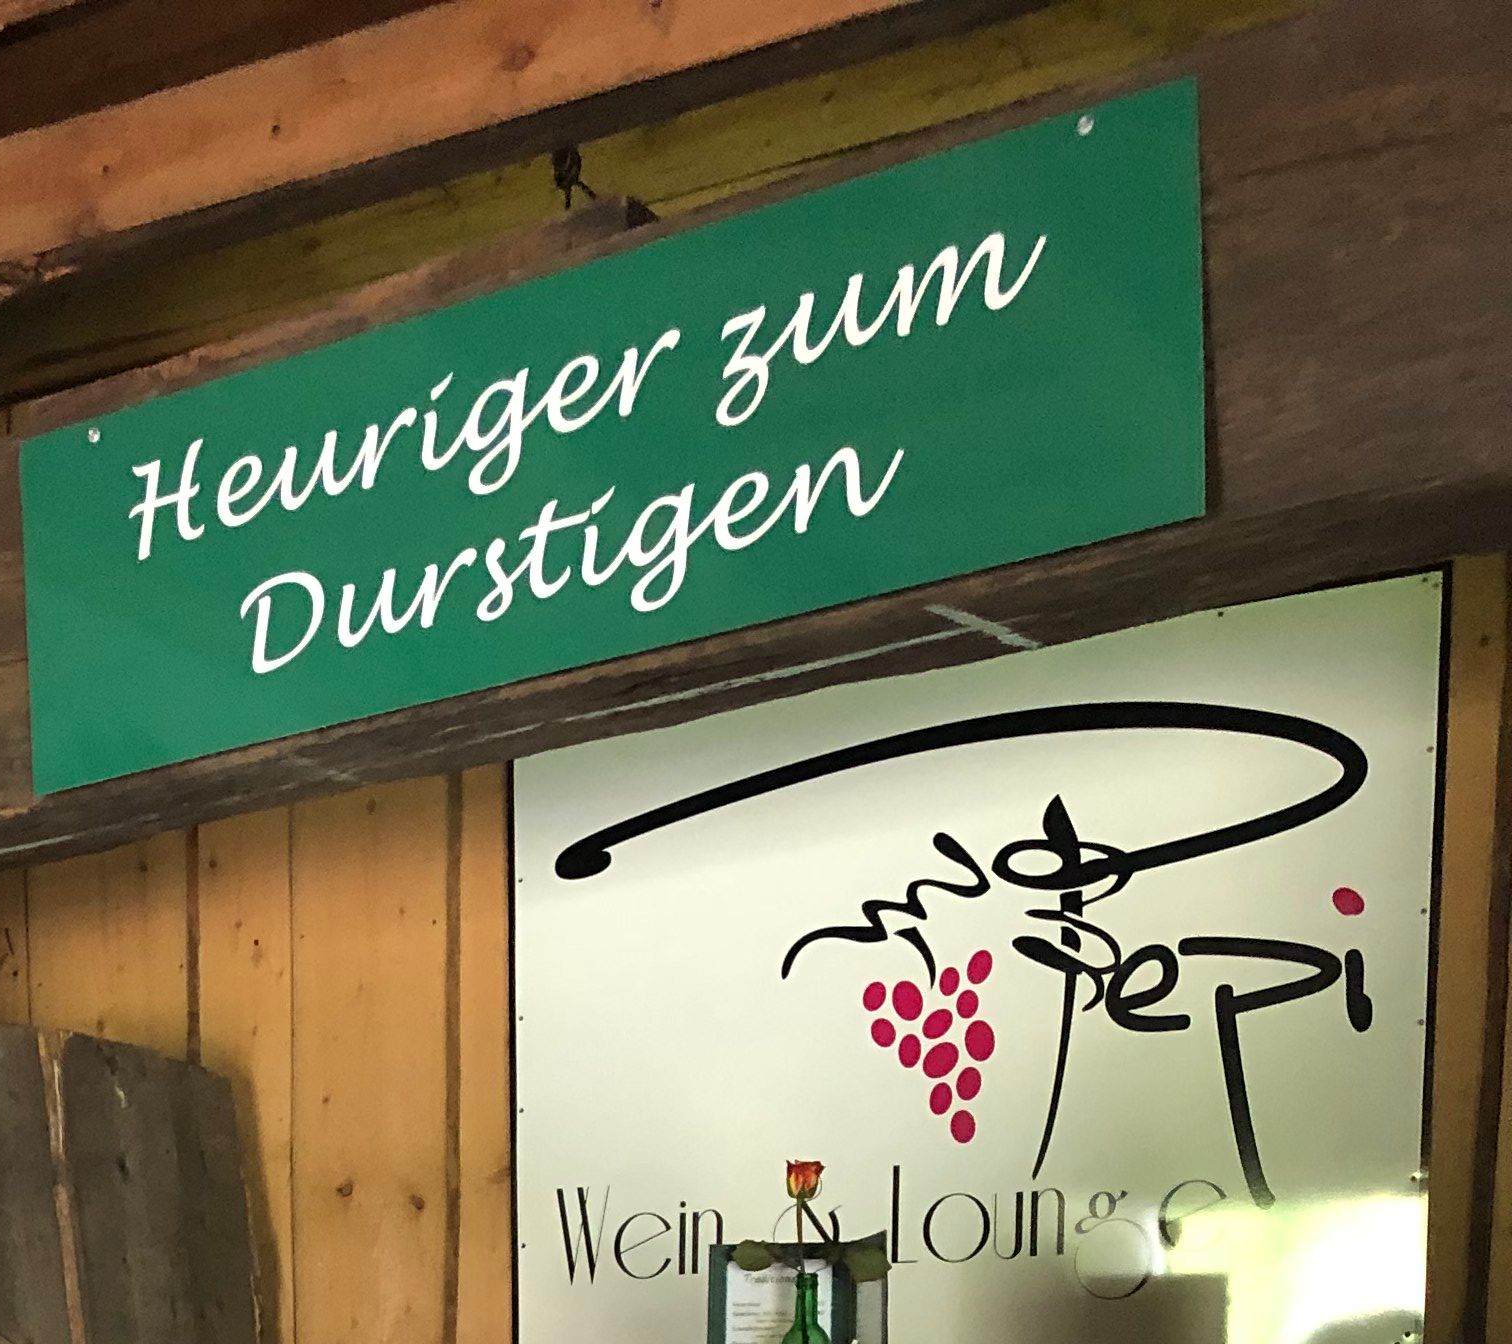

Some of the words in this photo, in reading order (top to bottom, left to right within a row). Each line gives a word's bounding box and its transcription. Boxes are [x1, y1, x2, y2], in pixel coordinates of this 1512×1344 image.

[128, 328, 681, 561] Heuriger
[714, 231, 1048, 427] zum
[239, 446, 905, 674] Durstigen
[556, 1184, 724, 1286] Wein
[890, 1164, 1227, 1300] Lounge
